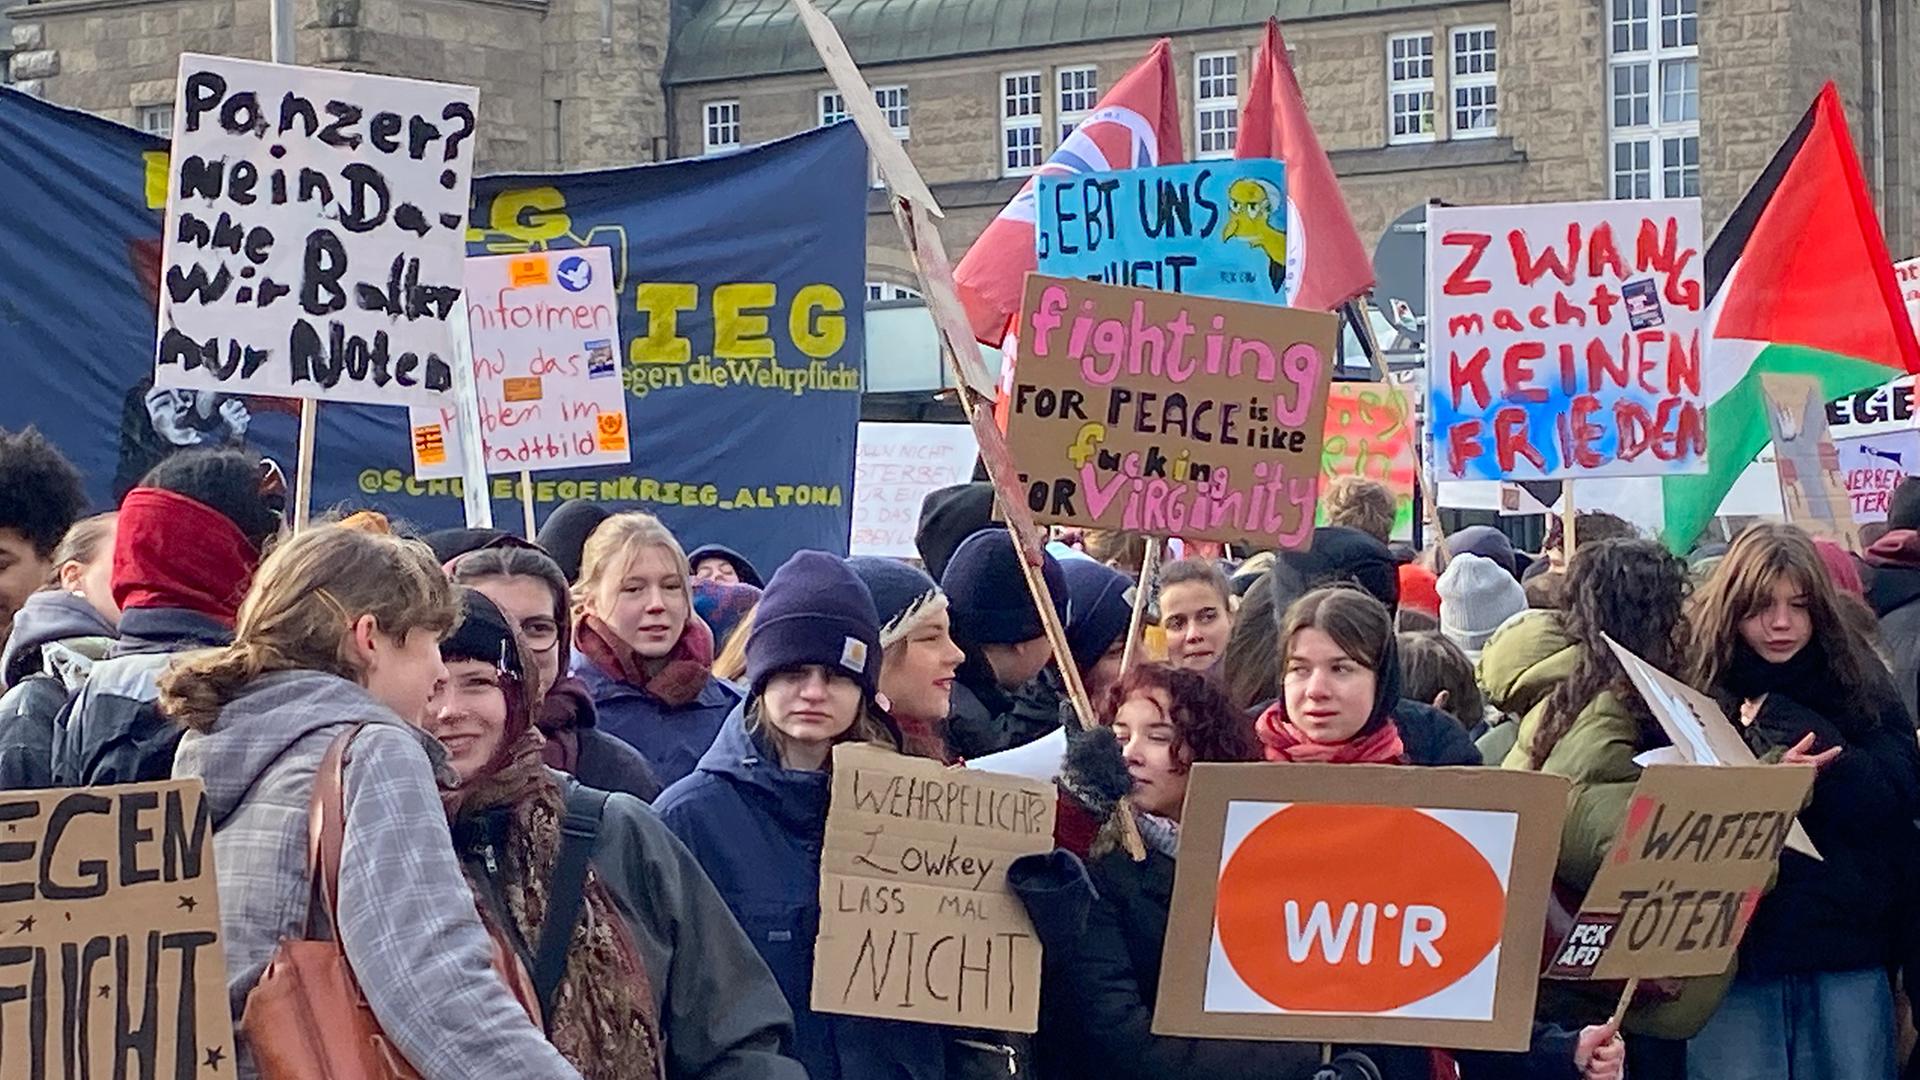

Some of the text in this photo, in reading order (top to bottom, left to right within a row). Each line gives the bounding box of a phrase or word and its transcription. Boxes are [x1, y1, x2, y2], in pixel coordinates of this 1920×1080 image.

[185, 71, 475, 190] Panzer?
[1138, 169, 1219, 239] UNS
[1441, 215, 1701, 312] ZWANG
[467, 287, 612, 330] niformen
[630, 283, 846, 364] IEG
[1448, 284, 1620, 338] macht
[530, 348, 580, 376] das
[622, 355, 861, 400] egen die Wehrpflicht
[1031, 285, 1322, 427] fighting
[1450, 329, 1701, 412] KEINEN
[482, 431, 595, 463] tadtbild
[1015, 384, 1269, 446] FOR PEACE is
[1247, 428, 1307, 454] like
[1448, 396, 1707, 478] FRIEDEN
[1018, 474, 1077, 518] OR
[852, 769, 1047, 835] WEHRPFLICHT?
[0, 789, 209, 901] EGEN
[852, 825, 994, 892] Lowkey
[839, 880, 989, 921] LASS MAL
[1556, 945, 1601, 966] AFD
[1569, 923, 1613, 946] FCK
[842, 928, 1030, 1014] NICHT
